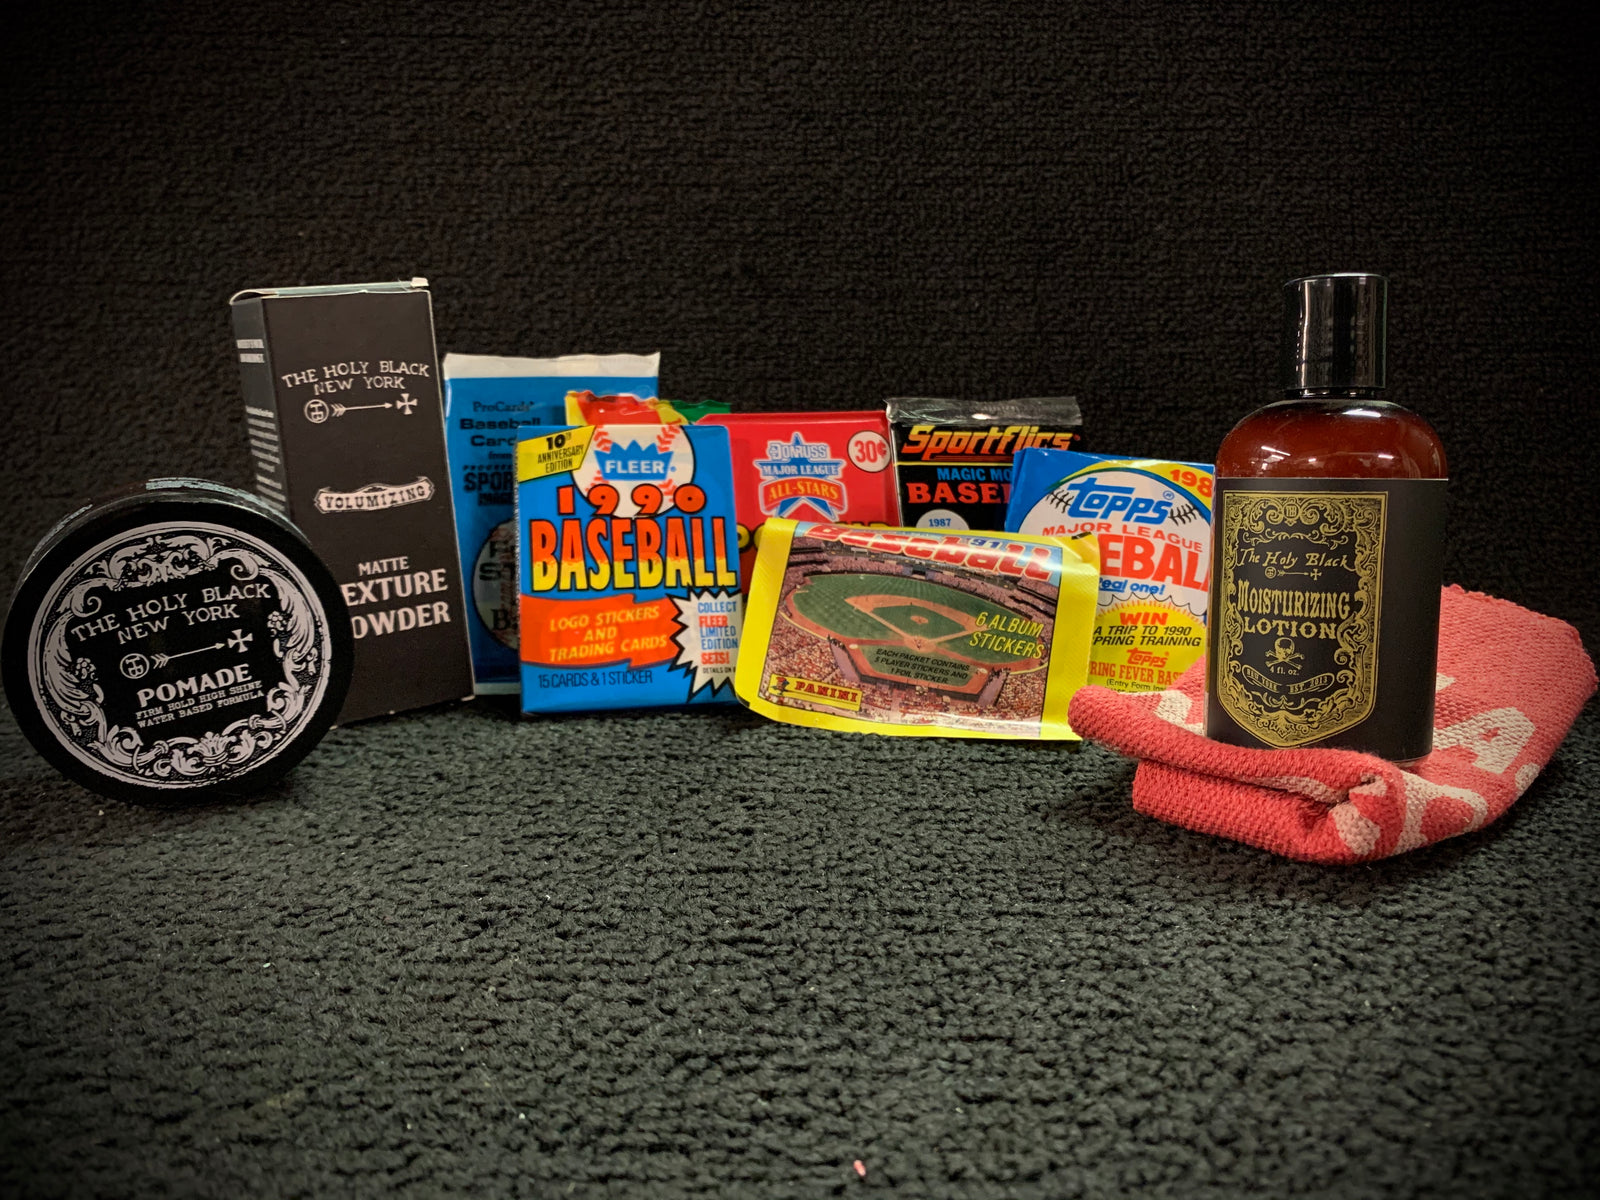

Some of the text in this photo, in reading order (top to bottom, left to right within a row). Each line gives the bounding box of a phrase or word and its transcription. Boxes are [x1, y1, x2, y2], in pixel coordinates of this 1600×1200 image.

[282, 360, 430, 388] THE HOLY BLACK
[314, 376, 406, 396] NEW YORK
[901, 424, 1074, 461] Sportflics
[538, 444, 584, 464] ANNIVERSARY
[546, 458, 572, 473] EDITION
[605, 460, 664, 474] FLEER
[762, 464, 838, 476] MAJOR LEAGUE
[937, 468, 986, 481] MAGIC
[464, 472, 513, 493] SPOR
[769, 480, 838, 501] ALL-STARS
[907, 482, 1012, 504] BASE
[1170, 469, 1212, 498] 198
[324, 485, 425, 509] VOLUMIZING
[557, 483, 706, 516] 1990
[928, 518, 952, 527] 1987
[1042, 522, 1203, 552] MAJOR LEAGUE
[529, 516, 738, 592] BASEBALL
[1098, 534, 1210, 592] EBAL
[1237, 548, 1356, 572] The Holy Black
[358, 556, 410, 576] MATTE
[340, 568, 448, 607] EXTURE
[1130, 583, 1165, 594] one!
[71, 584, 271, 642] THE HOLY BLACK
[550, 606, 660, 632] LOGO STICKERS
[698, 602, 736, 614] COLLECT
[1120, 612, 1168, 626] WIN
[117, 604, 240, 645] NEW YORK
[352, 601, 451, 639] OWDER
[698, 615, 728, 628] FLEER
[976, 612, 1044, 638] 6 ALBUM
[1094, 626, 1192, 636] A TRIP TO 1990
[1243, 616, 1337, 640] LOTION
[584, 626, 617, 642] AND
[700, 625, 736, 638] LIMITED
[1093, 636, 1201, 647] PRING TRAINING
[549, 634, 667, 663] TRADING CARDS
[701, 638, 738, 650] EDITION
[970, 631, 1046, 660] STICKERS
[701, 651, 730, 664] SETS!
[876, 648, 970, 671] EACH PACKET CONTAINS
[538, 670, 652, 689] 15 CARDS & 1 STICKER
[881, 658, 911, 668] PLAYER
[912, 663, 950, 675] STICKERS
[951, 671, 968, 680] AND
[914, 672, 948, 683] STICKER
[1090, 661, 1116, 678] RING
[1119, 664, 1154, 684] FEVER
[137, 664, 252, 707] POMADE
[794, 680, 858, 702] PANINI
[1131, 682, 1150, 690] Form
[136, 680, 262, 720] FIRM HOLD HIGH SHINE
[137, 690, 264, 728] WATER BASED FORMULA
